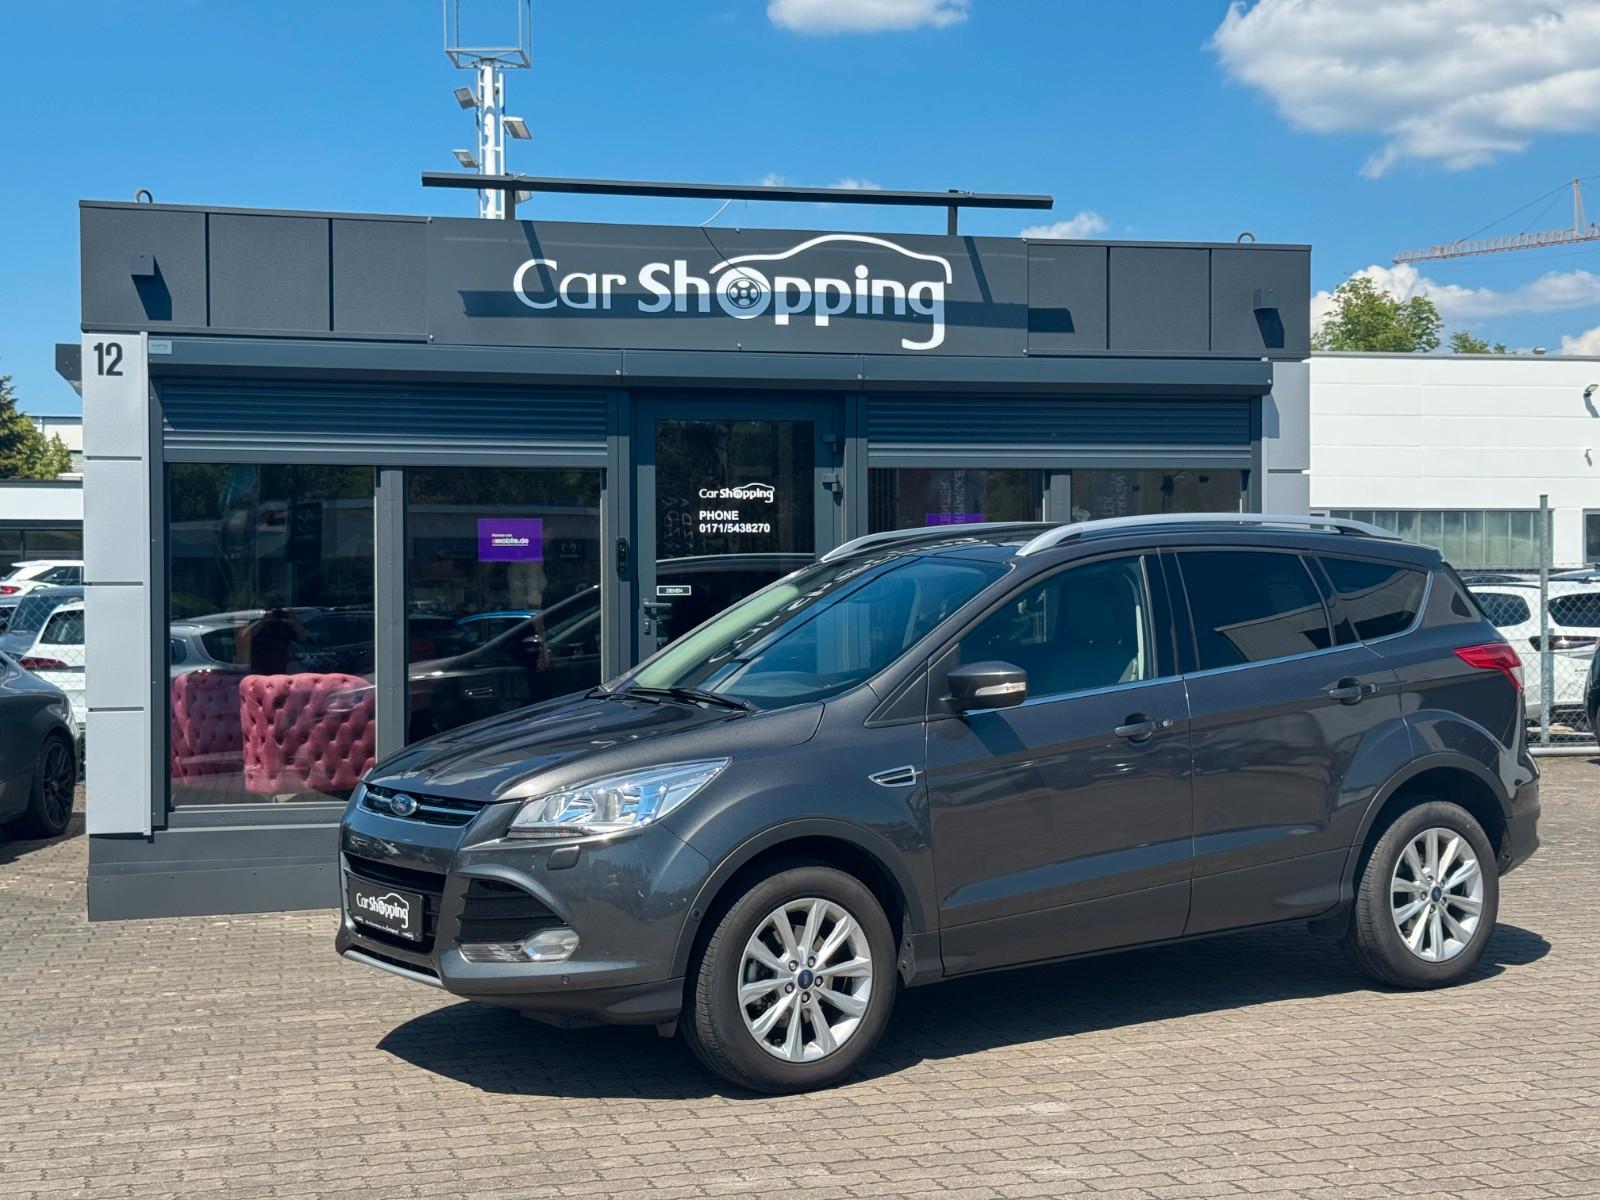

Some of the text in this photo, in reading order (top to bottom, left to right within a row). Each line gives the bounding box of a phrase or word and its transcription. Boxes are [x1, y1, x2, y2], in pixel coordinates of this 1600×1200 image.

[513, 258, 945, 351] Car Shopping
[93, 342, 124, 377] 12
[698, 486, 775, 504] Car Shopping
[699, 510, 740, 521] PHONE
[699, 523, 771, 533] 0171/5438270
[356, 892, 369, 909] Car
[369, 895, 410, 929] Shopping
